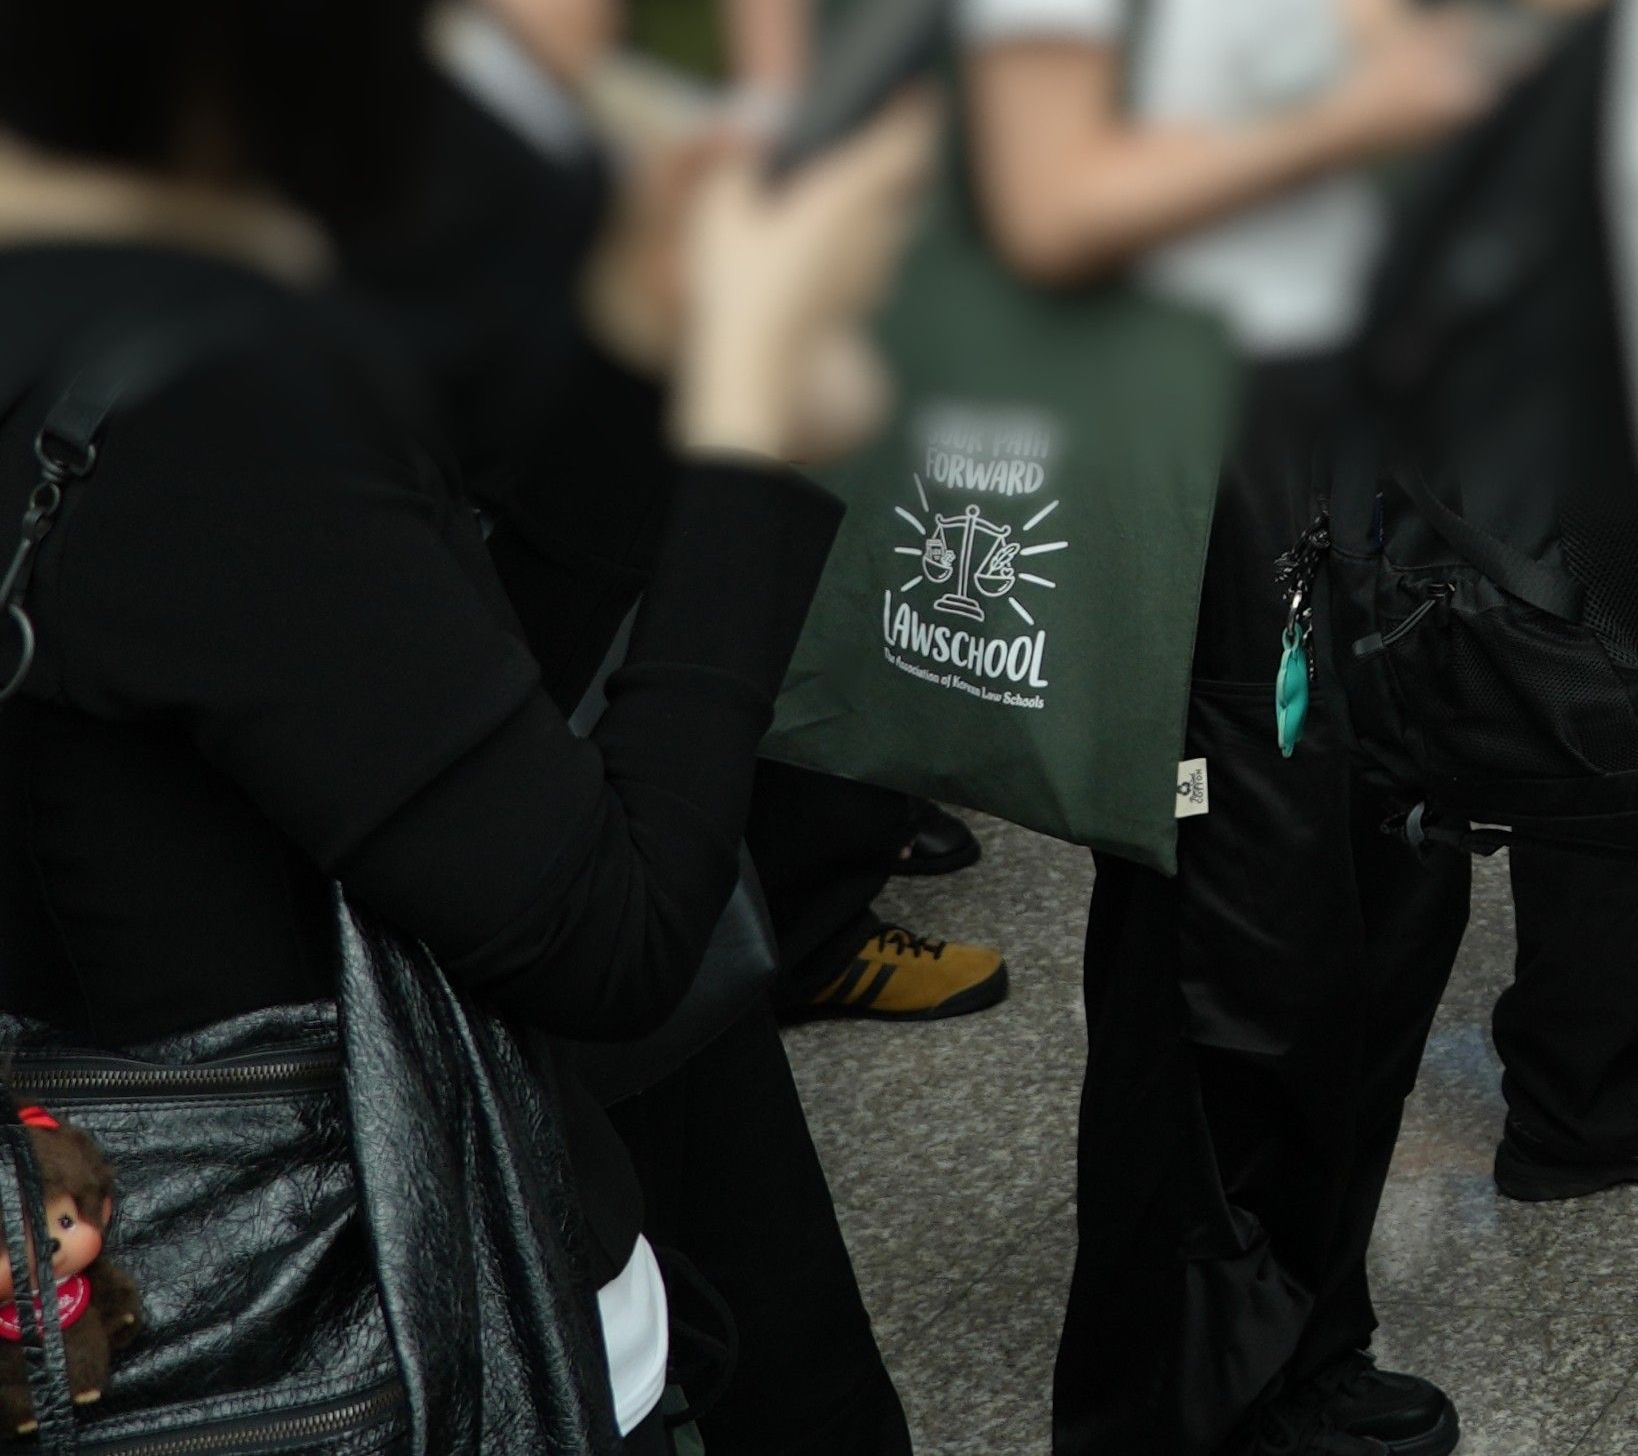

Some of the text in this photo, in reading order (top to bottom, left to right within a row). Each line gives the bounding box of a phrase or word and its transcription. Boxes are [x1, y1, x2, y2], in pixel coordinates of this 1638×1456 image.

[926, 447, 1045, 496] FORWARD
[883, 589, 1049, 688] LAWSCHOOL
[1003, 691, 1045, 709] Schools
